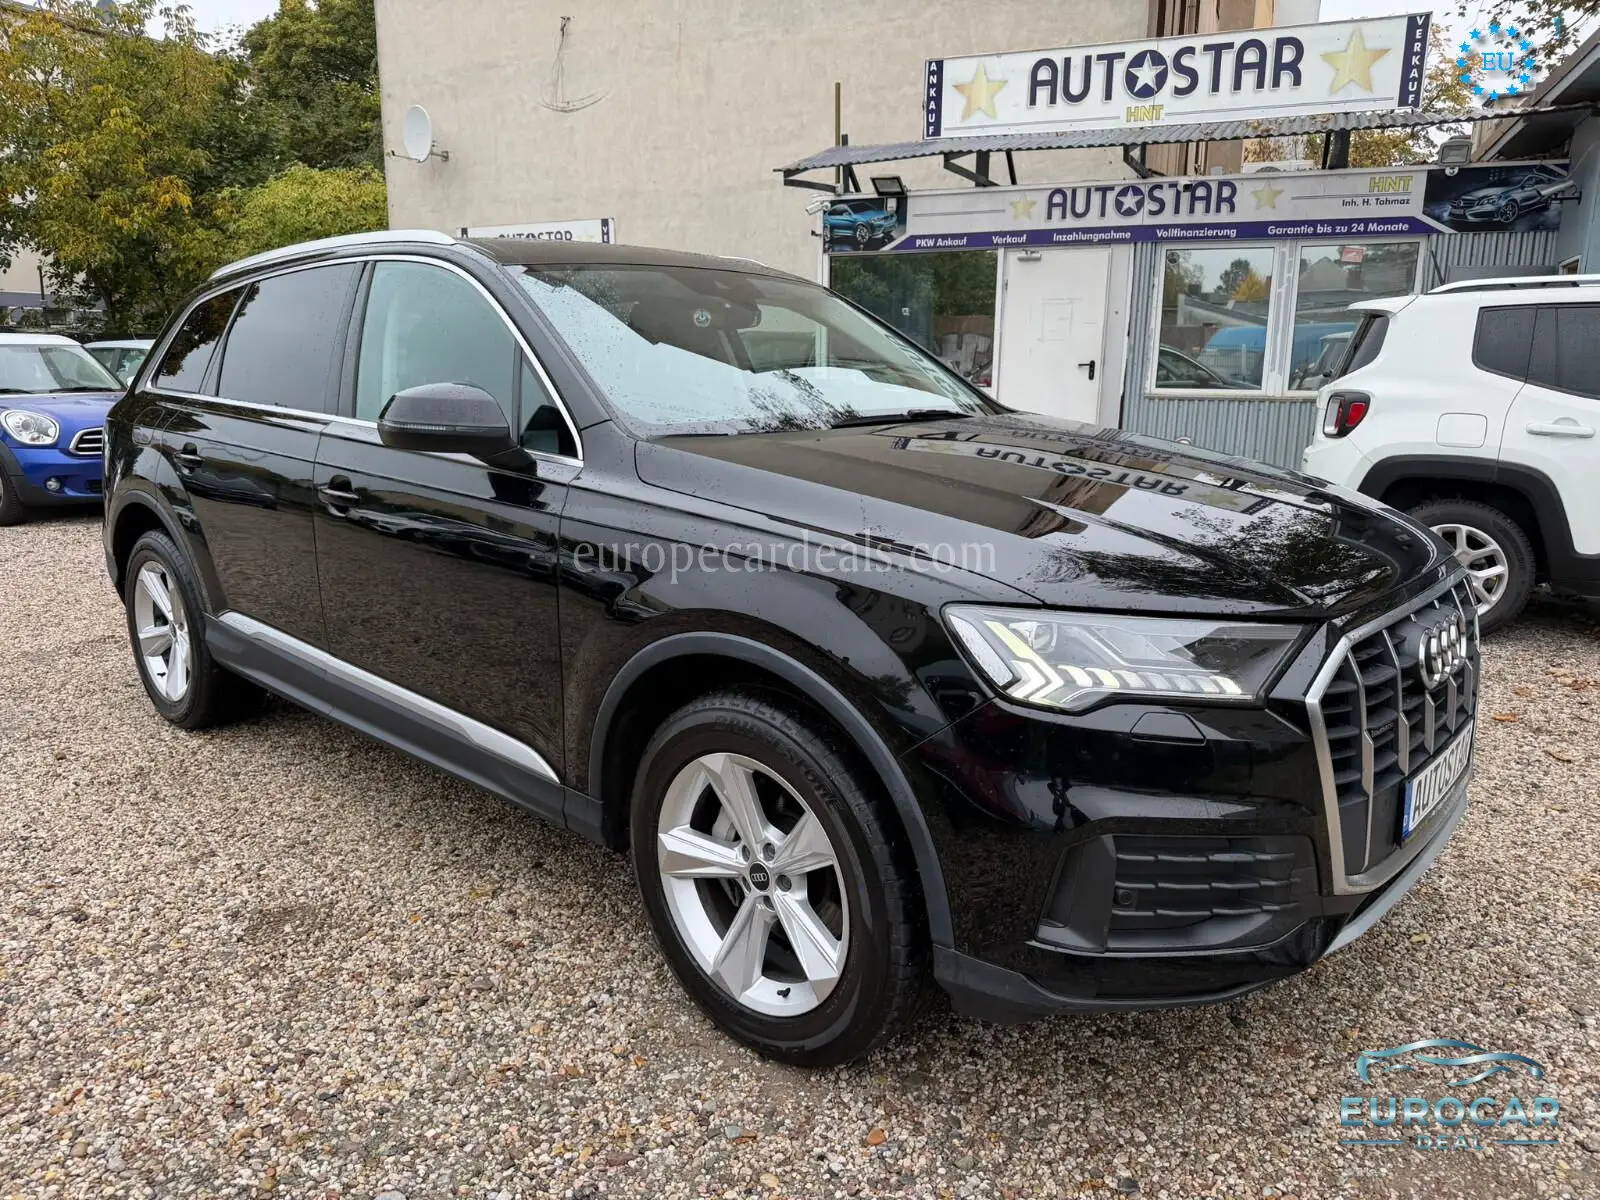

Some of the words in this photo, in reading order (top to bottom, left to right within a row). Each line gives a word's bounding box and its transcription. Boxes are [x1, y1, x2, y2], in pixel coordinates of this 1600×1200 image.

[1028, 35, 1305, 107] AUTOSTAR
[1407, 15, 1426, 104] VERKAUF
[928, 61, 938, 136] ANKAUF
[1126, 104, 1164, 122] HNT
[1046, 180, 1238, 220] AUTOSTAR
[1369, 175, 1413, 193] HNT
[1342, 199, 1359, 207] Inh.
[1362, 199, 1371, 207] H.
[1375, 197, 1411, 206] Tahmaz
[915, 238, 935, 248] PKW
[936, 236, 967, 247] Ankauf
[992, 233, 1027, 244] Verkauf
[1053, 230, 1131, 242] Inzahlungnahme
[1155, 227, 1237, 238] Vollfinanzierung
[1267, 223, 1313, 235] Garantie
[1316, 223, 1332, 233] bis
[1335, 224, 1348, 233] zu
[1351, 222, 1364, 232] 24
[1367, 222, 1409, 232] Monate
